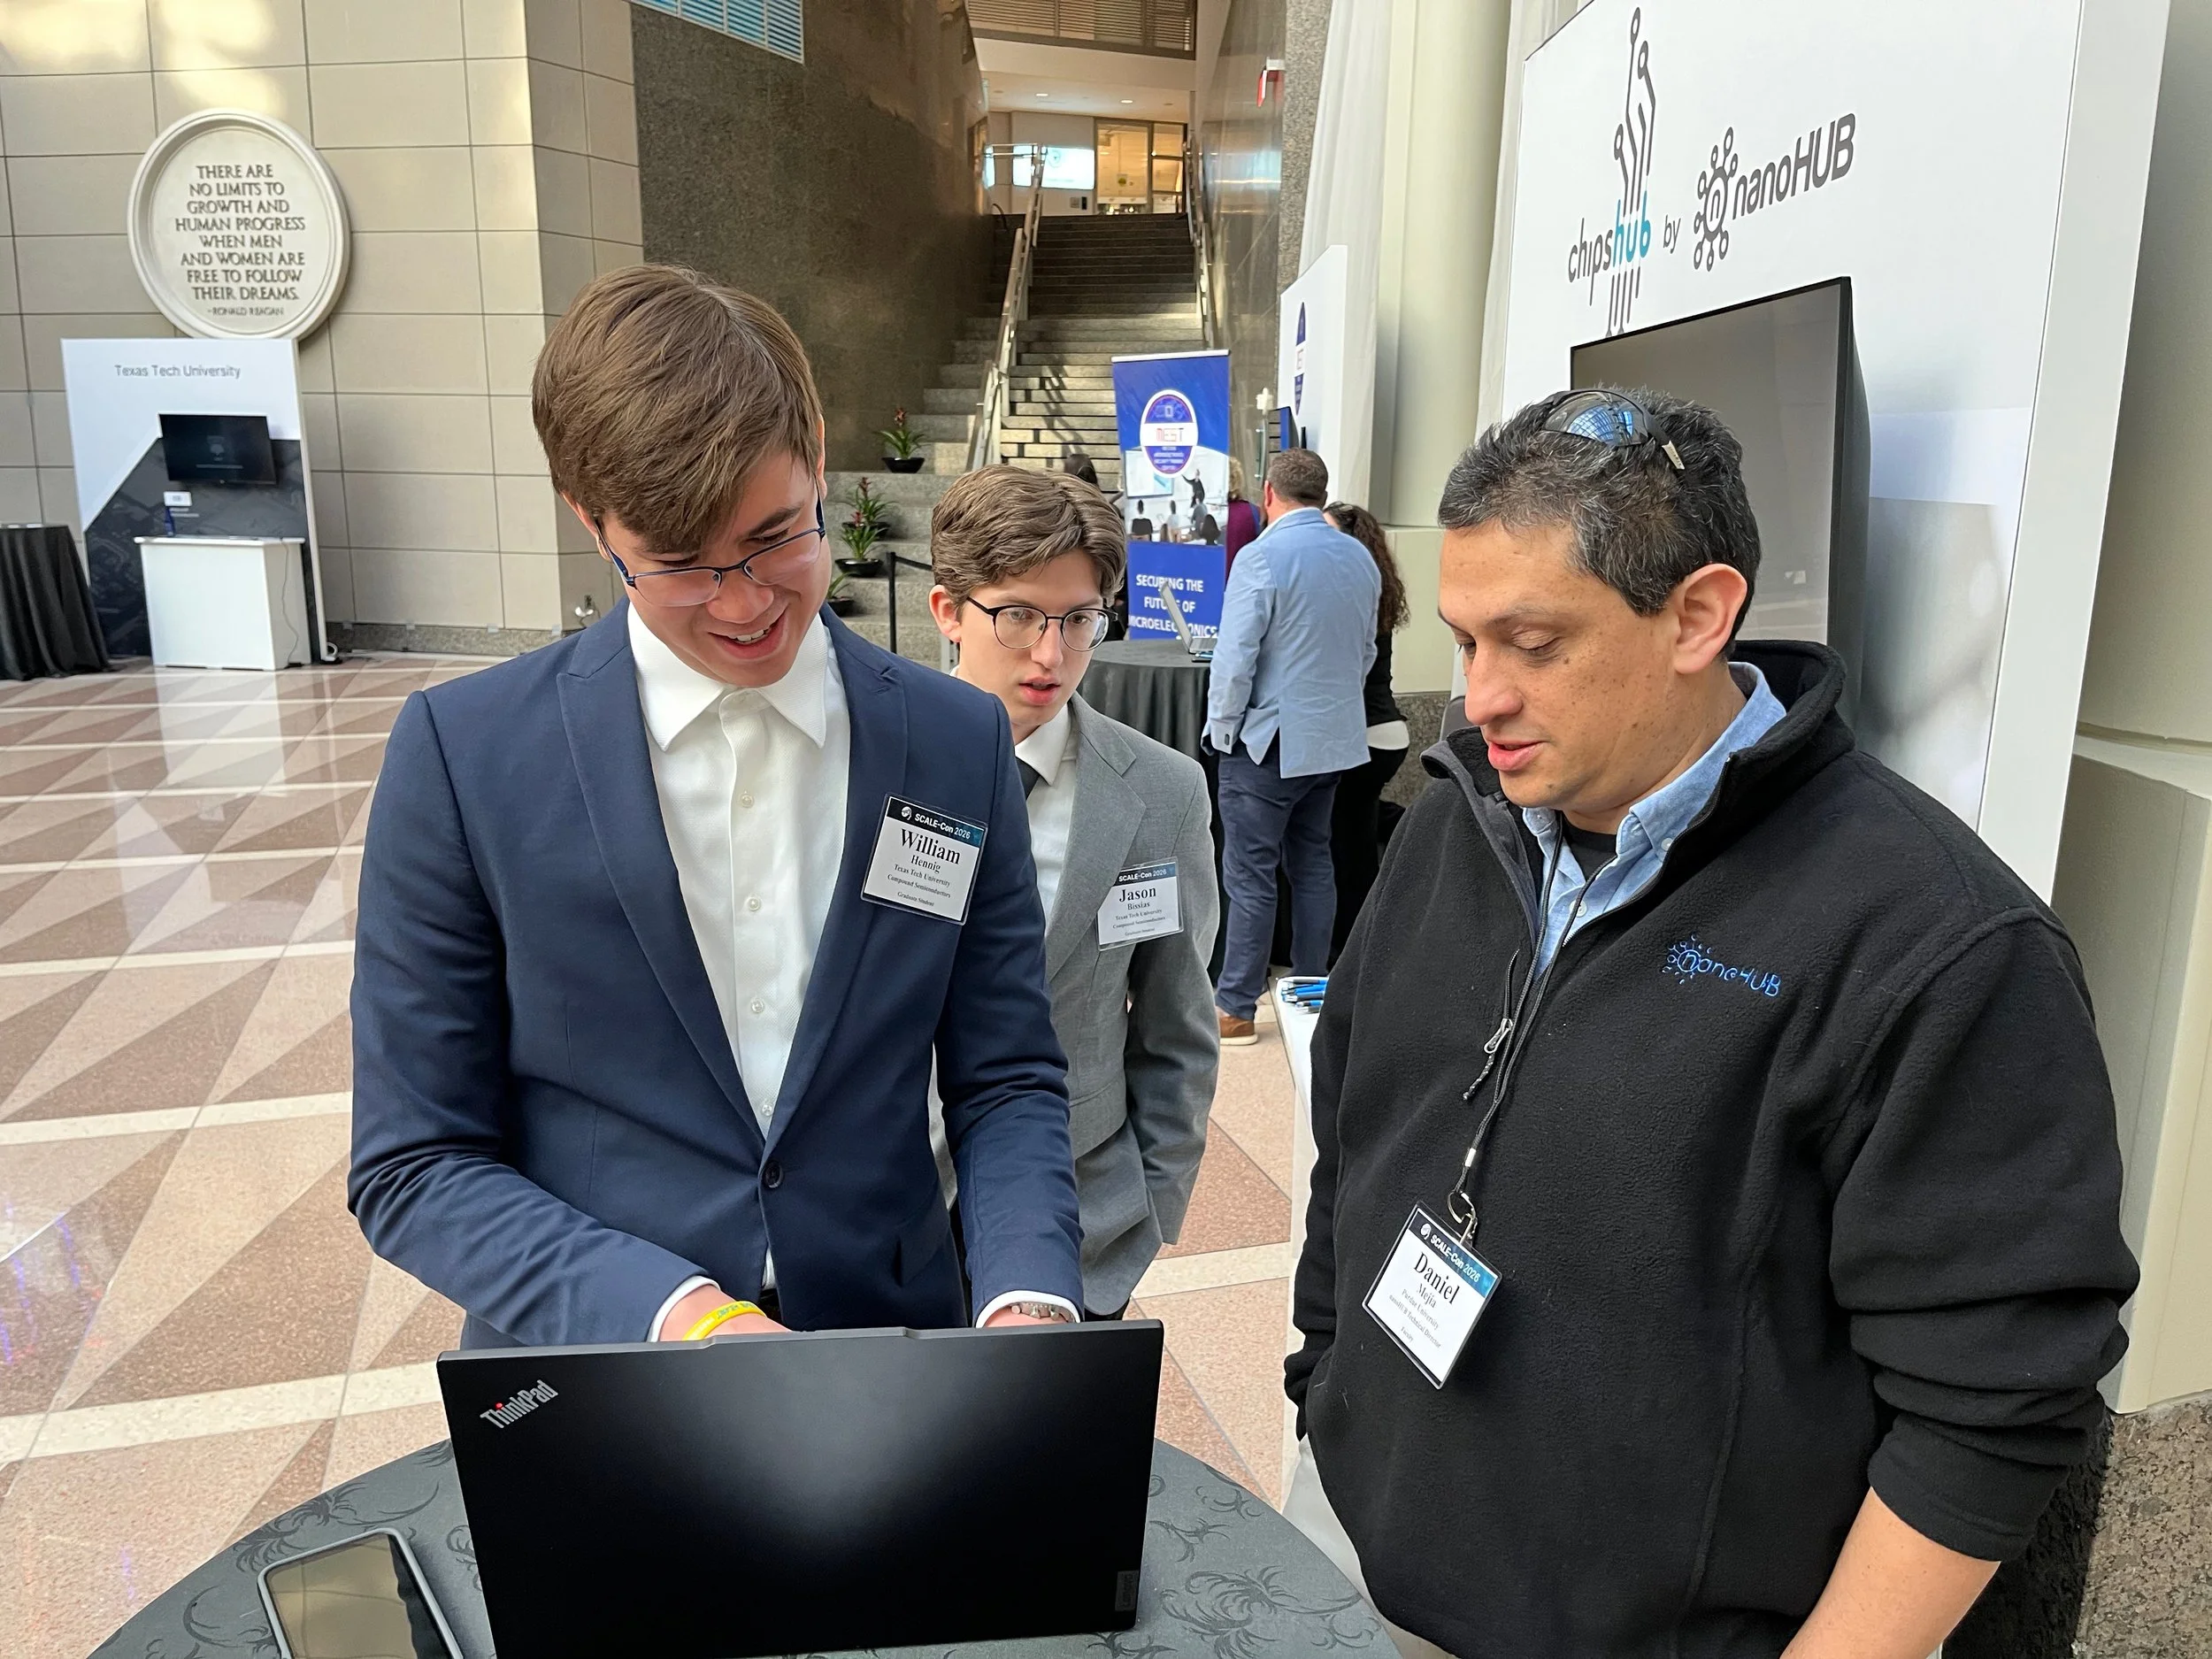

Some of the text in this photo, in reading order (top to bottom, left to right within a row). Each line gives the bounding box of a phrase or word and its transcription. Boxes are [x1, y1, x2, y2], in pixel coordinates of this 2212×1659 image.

[196, 165, 273, 179] THERE ARE
[189, 182, 284, 196] NO LIMITS TO
[1663, 215, 1680, 254] by
[1732, 113, 1855, 219] nanoHUB
[188, 199, 289, 214] GROWTH AND
[175, 218, 305, 231] HUMAN PROGRESS
[199, 235, 282, 248] WHEN MEN
[180, 252, 305, 265] AND WOMEN ARE
[188, 270, 302, 282] FREE TO FOLLOW
[192, 288, 236, 300] THEIR
[114, 365, 241, 380] Texas Tech University
[1186, 580, 1203, 592] THE
[1144, 596, 1195, 613] FUTU OF
[1128, 615, 1217, 638] MICROELECONICS
[915, 813, 971, 840] SCALE-Con 2026
[901, 828, 960, 864] William
[911, 855, 941, 874] Hennig
[887, 874, 913, 887] Compound
[895, 864, 950, 888] Texas Tech University
[1119, 872, 1152, 882] SCALE-Con
[1119, 887, 1156, 902] Jason
[1430, 1234, 1481, 1282] SCALE-Con 2026
[1414, 1252, 1460, 1305] Daniel
[1417, 1283, 1437, 1309] Mejia
[1417, 1304, 1439, 1331] University
[480, 1379, 558, 1428] ThinkPad
